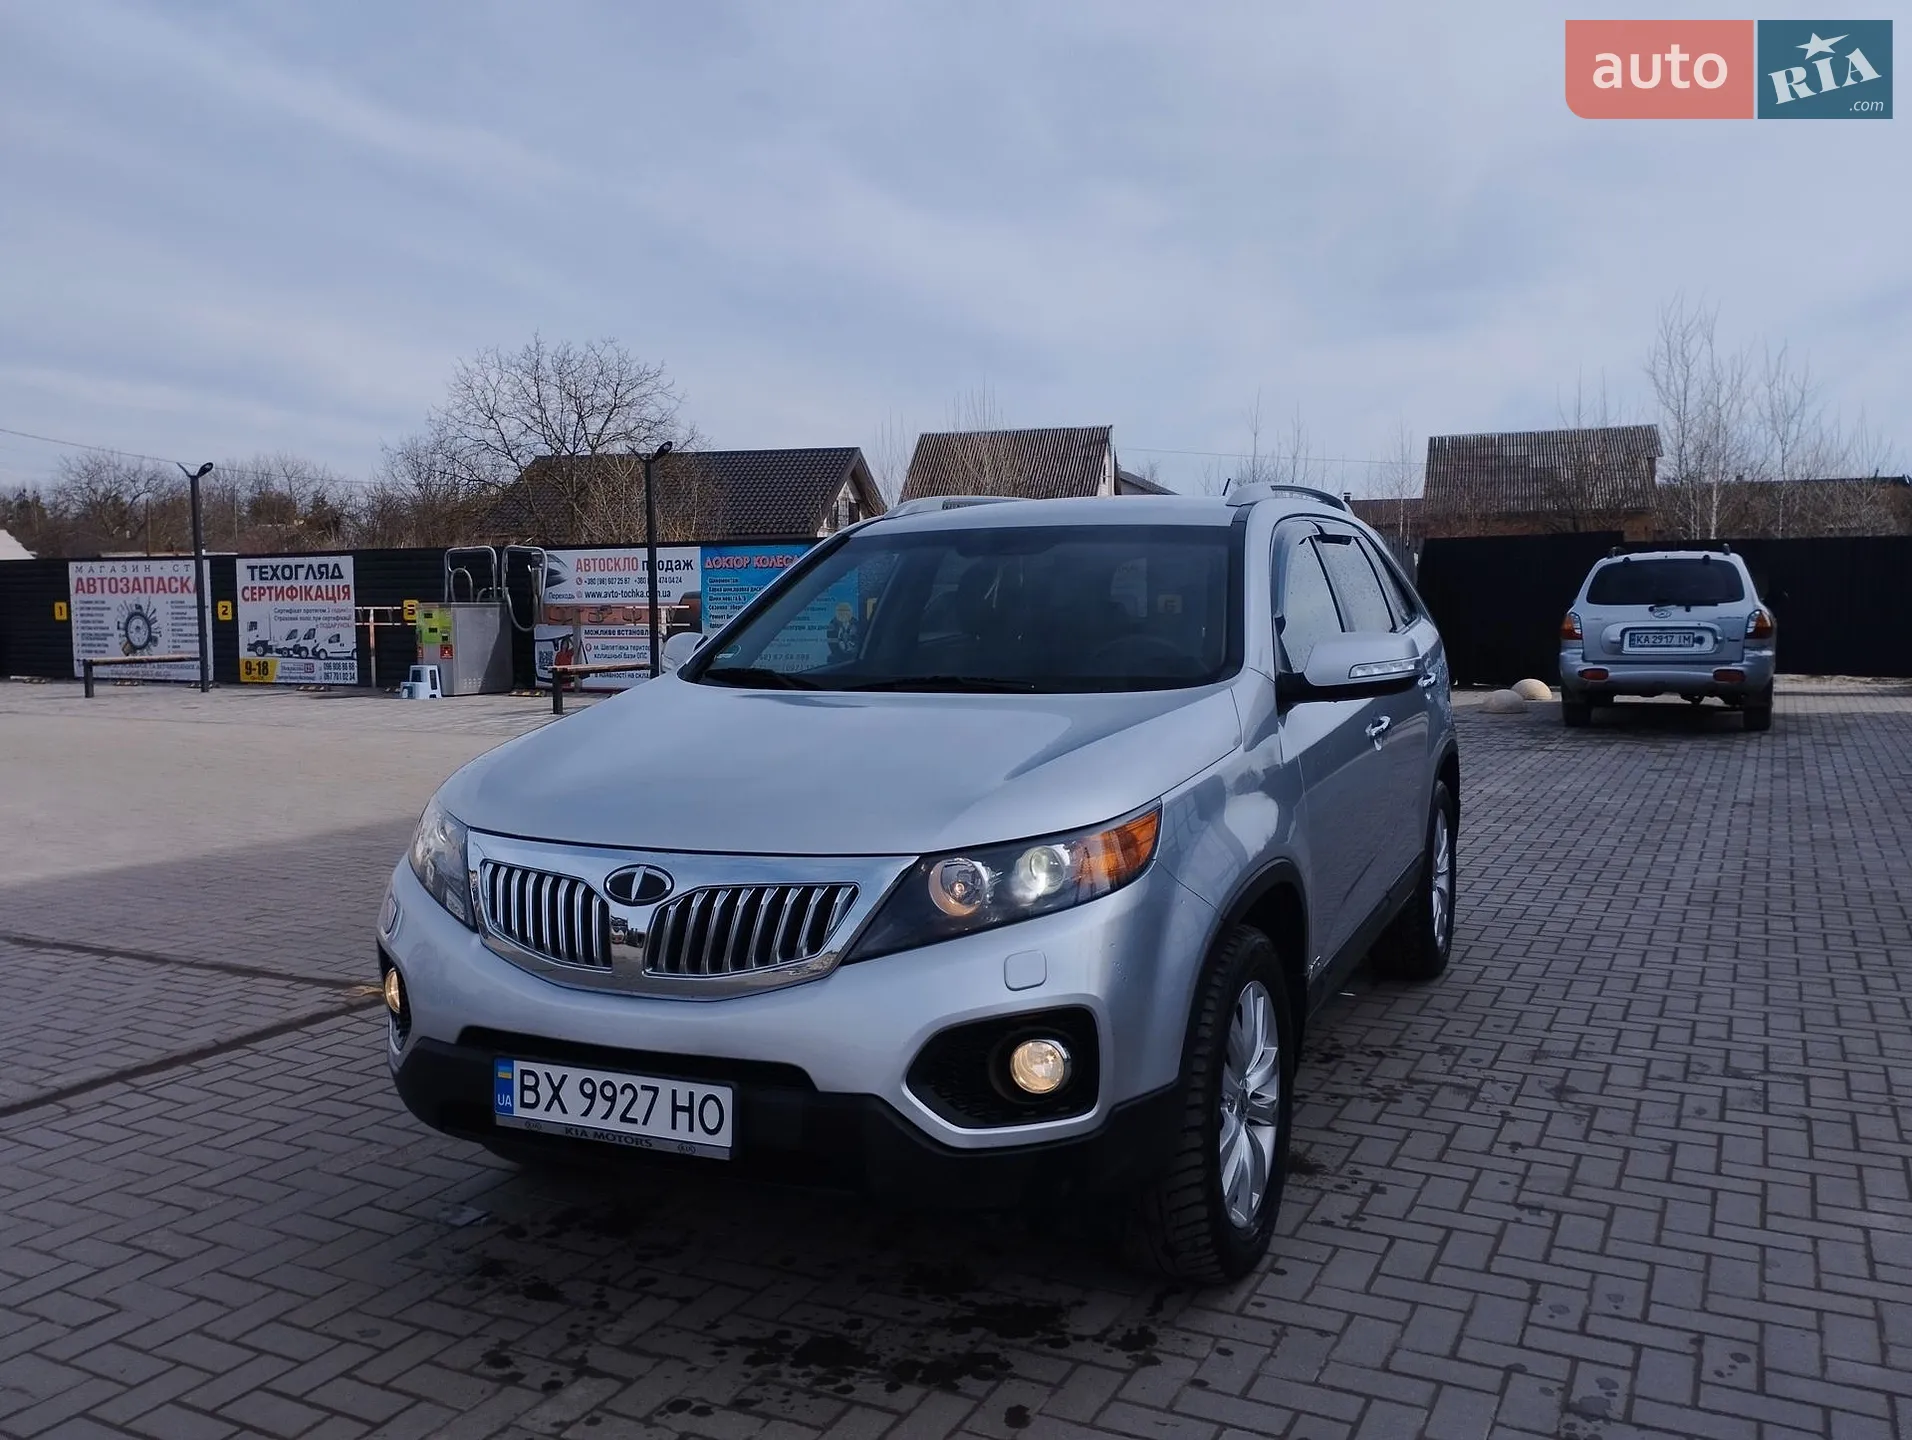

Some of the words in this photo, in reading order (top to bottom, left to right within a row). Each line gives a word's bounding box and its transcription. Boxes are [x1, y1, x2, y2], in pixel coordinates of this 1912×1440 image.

[75, 564, 151, 573] МАГАЗИН
[172, 563, 191, 572] СТ
[576, 557, 639, 572] АВТОСКЛО
[642, 559, 694, 572] подаж
[705, 555, 751, 569] ДОКТОР
[247, 563, 344, 581] ТЕХОГЛЯД
[241, 584, 351, 603] СЕРТИФІКАЦІЯ
[585, 588, 671, 599] www.avto-tochka.cm.ua
[221, 605, 229, 616] 2
[1636, 634, 1650, 644] KA
[1652, 634, 1675, 644] 2917
[245, 660, 269, 676] 9-18
[497, 1093, 513, 1108] UA
[519, 1068, 569, 1115] BX
[579, 1077, 660, 1126] 9927
[671, 1088, 725, 1136] HO
[564, 1126, 588, 1138] KIA
[592, 1130, 653, 1148] MOTORS
